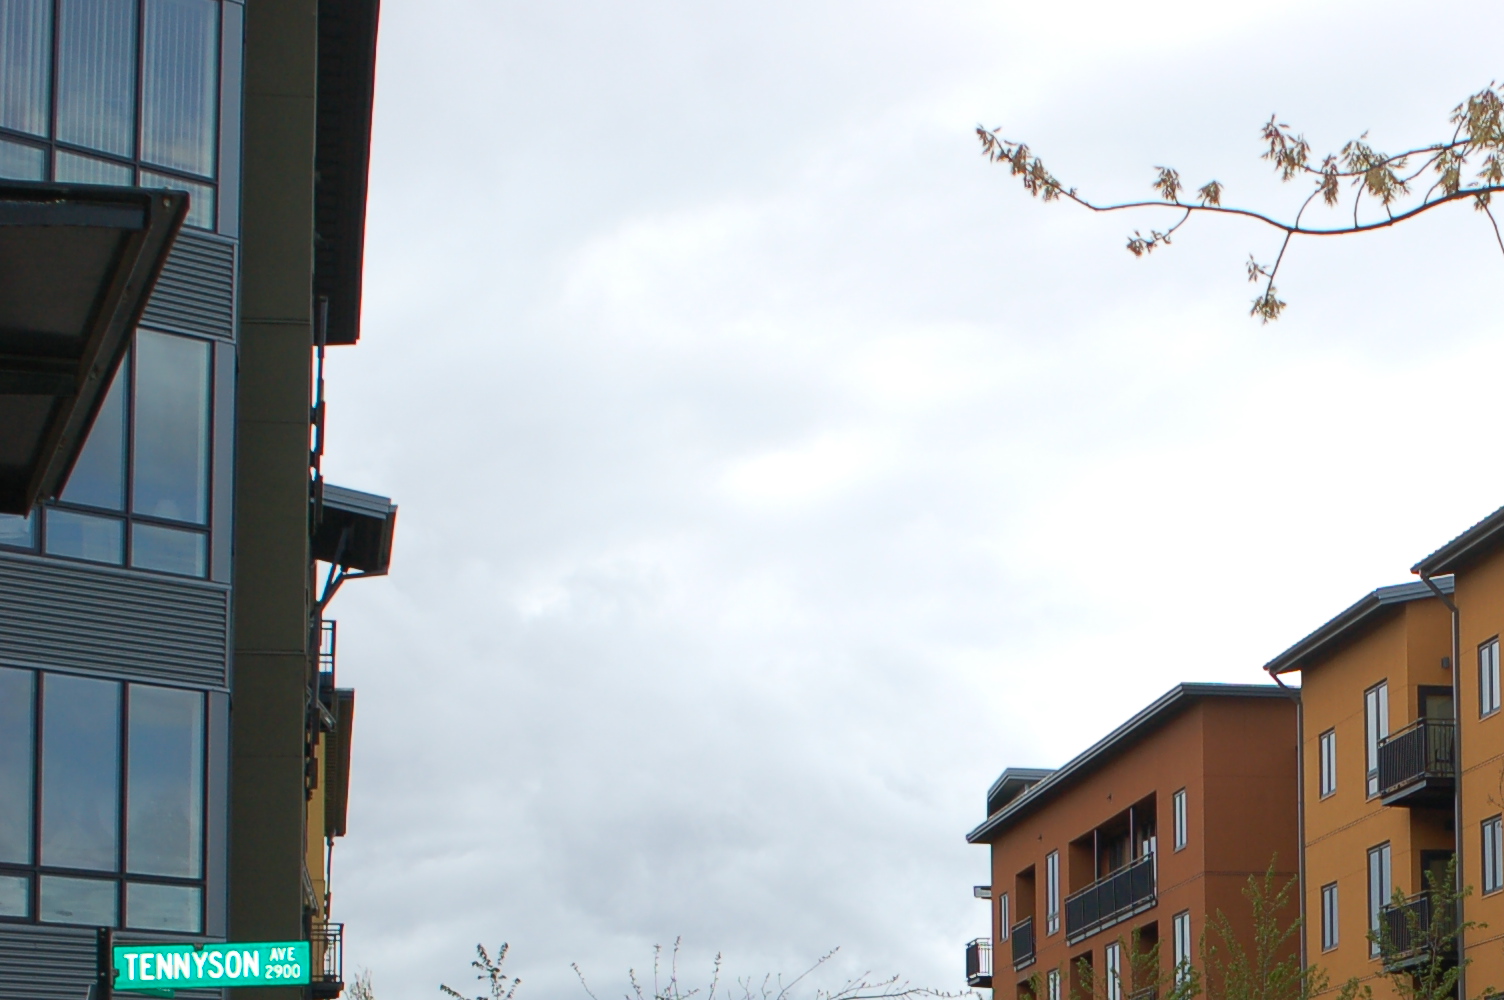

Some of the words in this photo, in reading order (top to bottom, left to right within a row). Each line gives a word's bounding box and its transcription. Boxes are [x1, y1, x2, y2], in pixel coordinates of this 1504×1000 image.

[124, 950, 260, 981] TENNYSON
[269, 947, 296, 962] AVE
[265, 963, 301, 980] 2900
